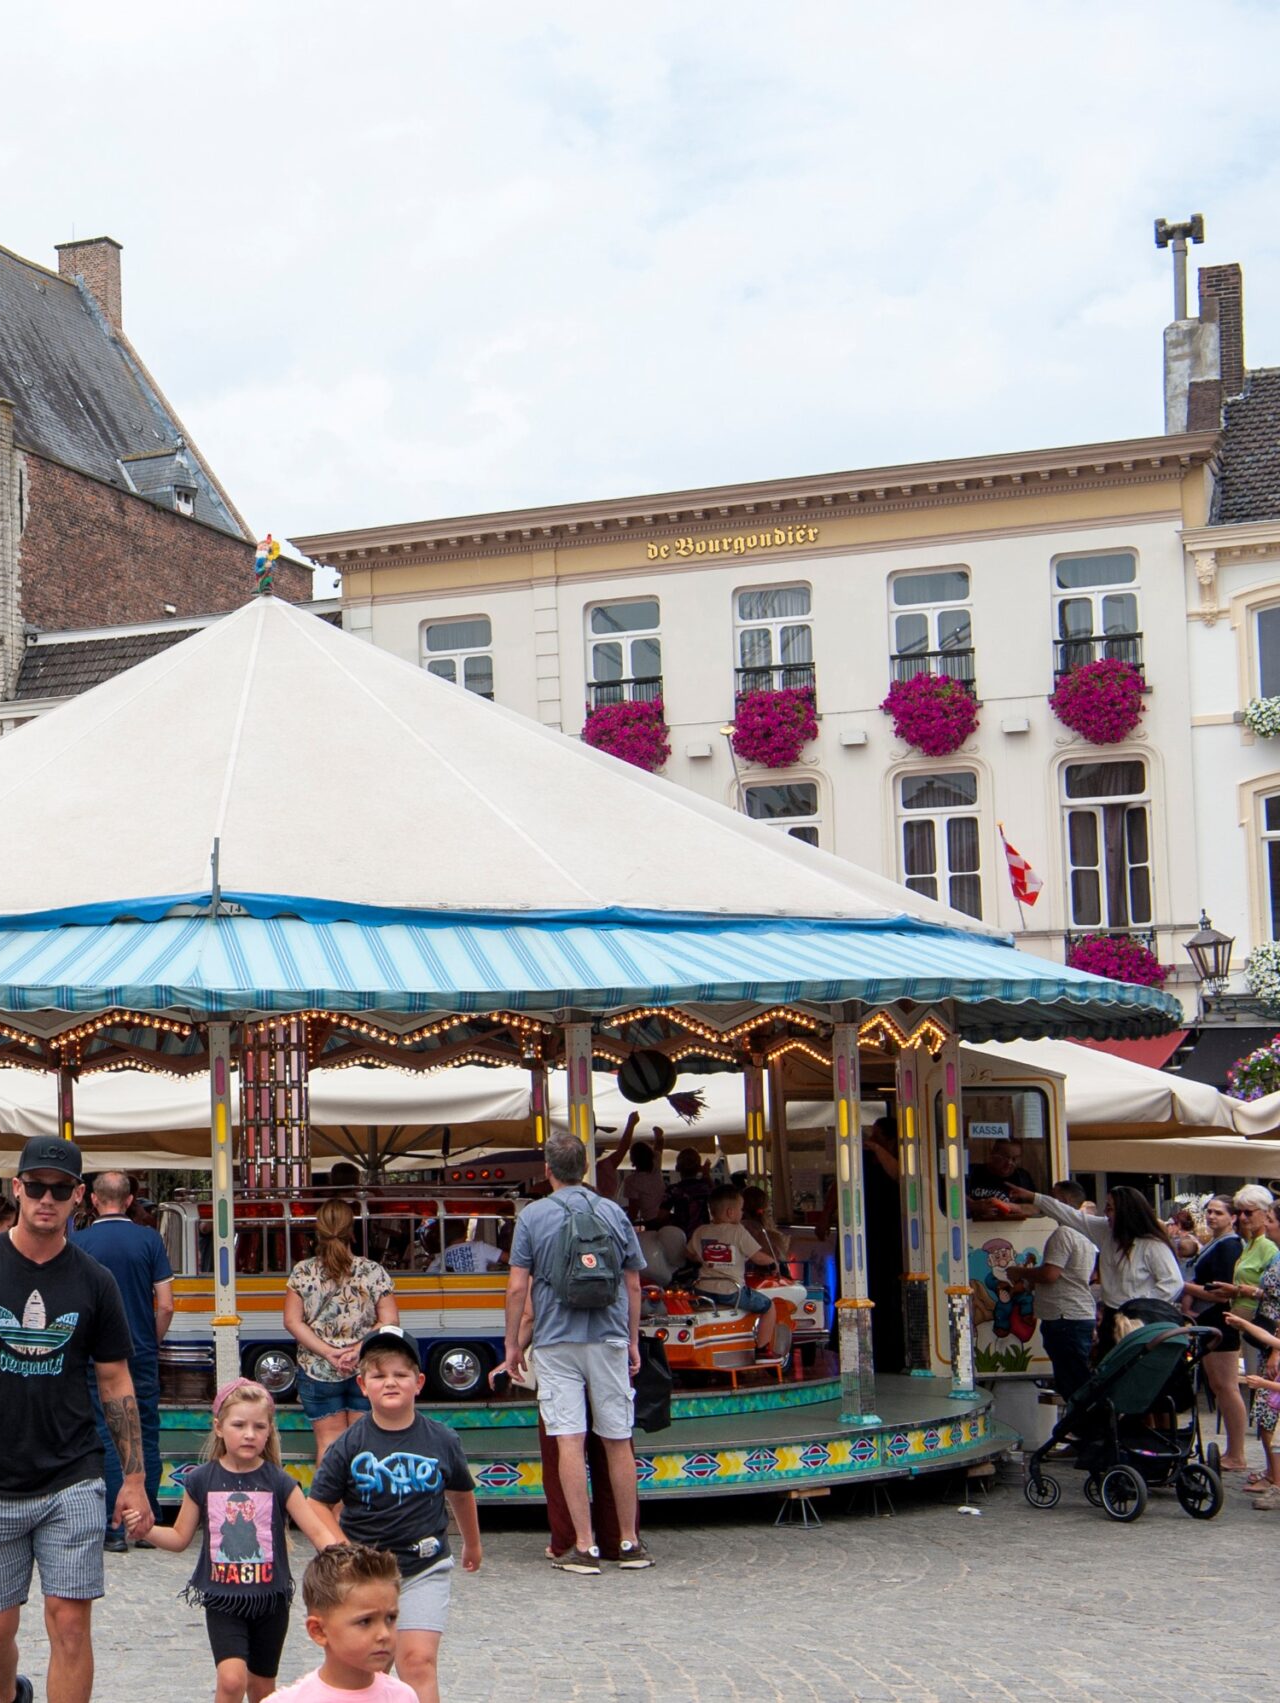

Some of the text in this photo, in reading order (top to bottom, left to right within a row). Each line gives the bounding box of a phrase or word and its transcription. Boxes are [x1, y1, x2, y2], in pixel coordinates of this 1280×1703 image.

[647, 524, 820, 560] de Bourgondiër
[971, 1125, 1004, 1136] KASSA
[446, 1246, 472, 1258] RUSH
[211, 1562, 273, 1584] MAGIC
